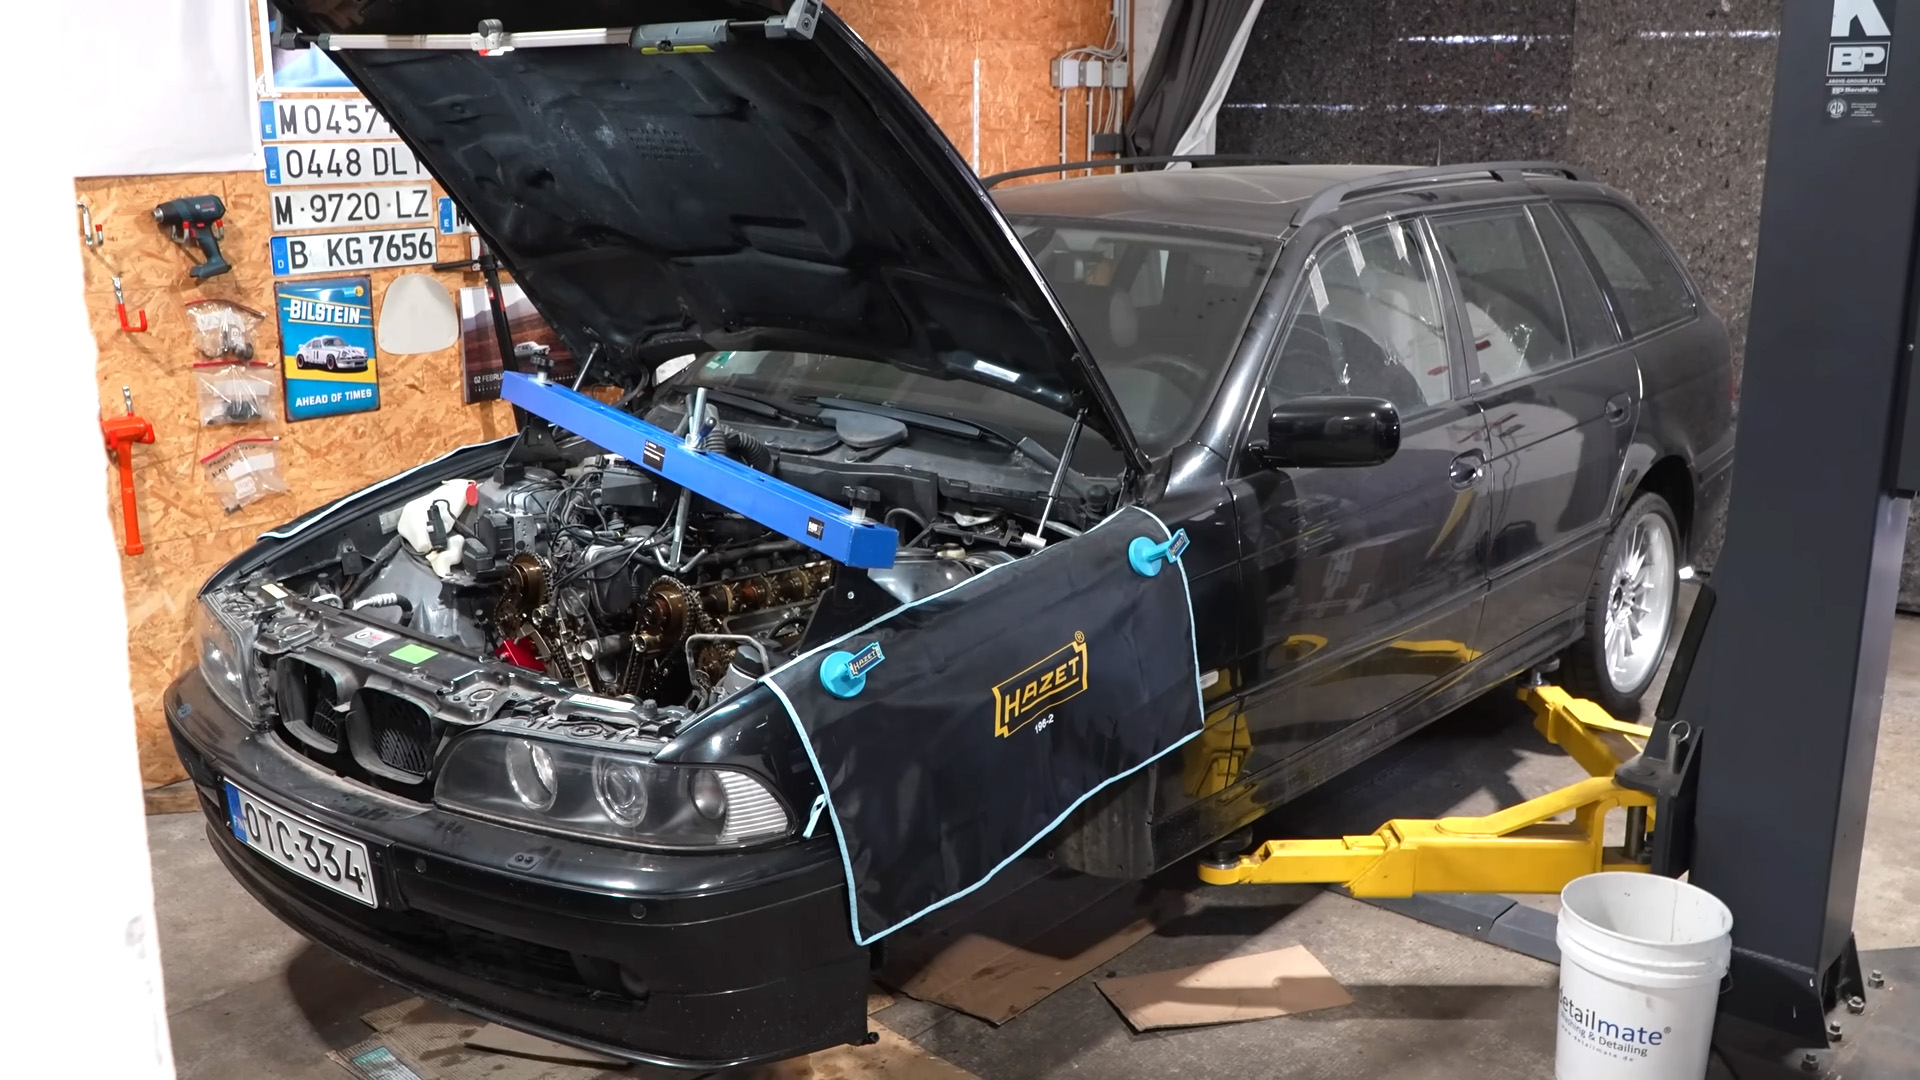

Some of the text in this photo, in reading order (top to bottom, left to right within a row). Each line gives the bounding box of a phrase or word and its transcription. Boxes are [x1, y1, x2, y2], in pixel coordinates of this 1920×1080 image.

[1831, 46, 1885, 72] BP
[265, 124, 272, 133] E
[373, 147, 420, 176] DL
[270, 170, 276, 179] E
[278, 260, 284, 269] D
[290, 241, 308, 270] B
[289, 299, 361, 324] BILSTEIN
[295, 388, 372, 407] AHEAD OF TIMES
[854, 650, 877, 673] HAZET
[1005, 656, 1079, 724] HAZET
[1035, 713, 1054, 734] 196-2
[245, 801, 365, 893] OTC-334
[1599, 1036, 1648, 1057] Detailing
